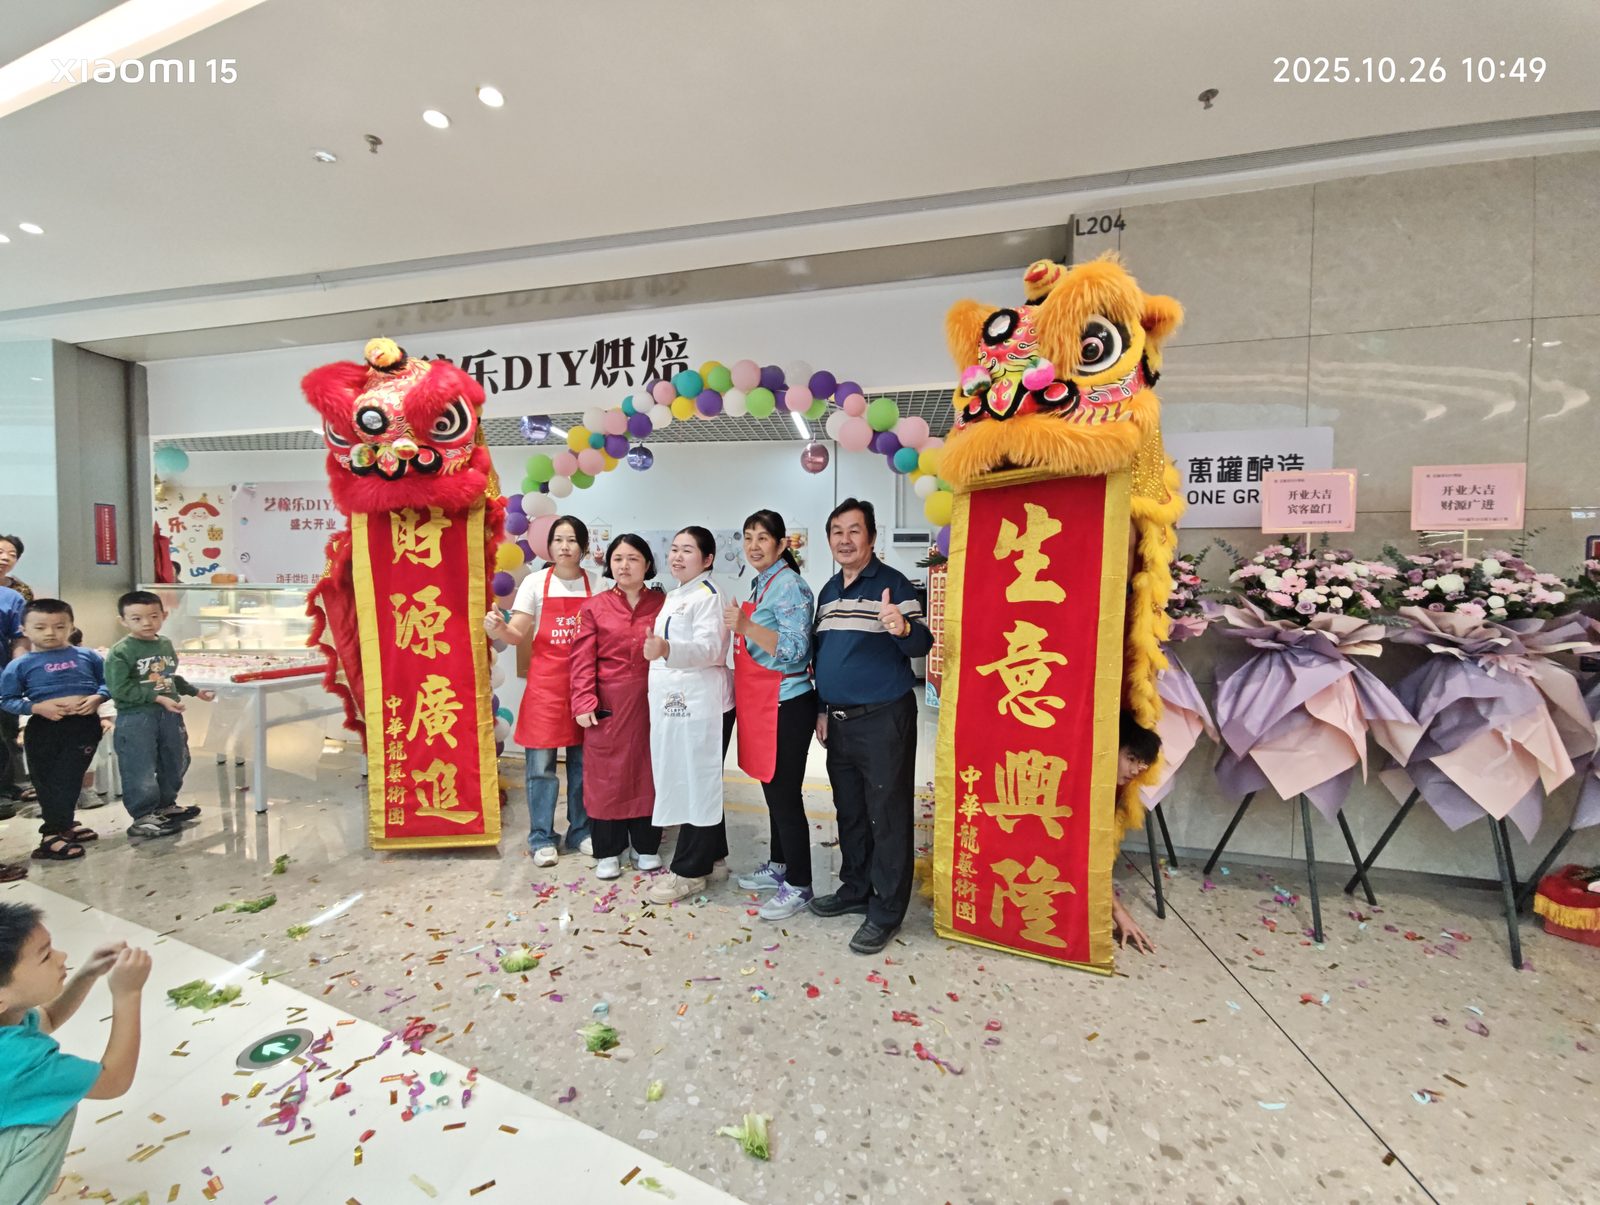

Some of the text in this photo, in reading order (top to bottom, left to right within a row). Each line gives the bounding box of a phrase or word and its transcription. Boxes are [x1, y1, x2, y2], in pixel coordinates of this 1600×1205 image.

[1076, 214, 1126, 236] L204
[421, 332, 688, 394] 乐DIY烘焙
[1187, 489, 1262, 505] ONE GR
[1289, 489, 1332, 500] 开业大吉
[1442, 484, 1496, 496] 开业大吉
[1288, 504, 1332, 515] 宾客盈门
[1441, 499, 1495, 511] 财源广进
[290, 518, 337, 530] 盛大开业
[390, 505, 479, 824] 財源廣進
[976, 502, 1077, 949] 生意興隆
